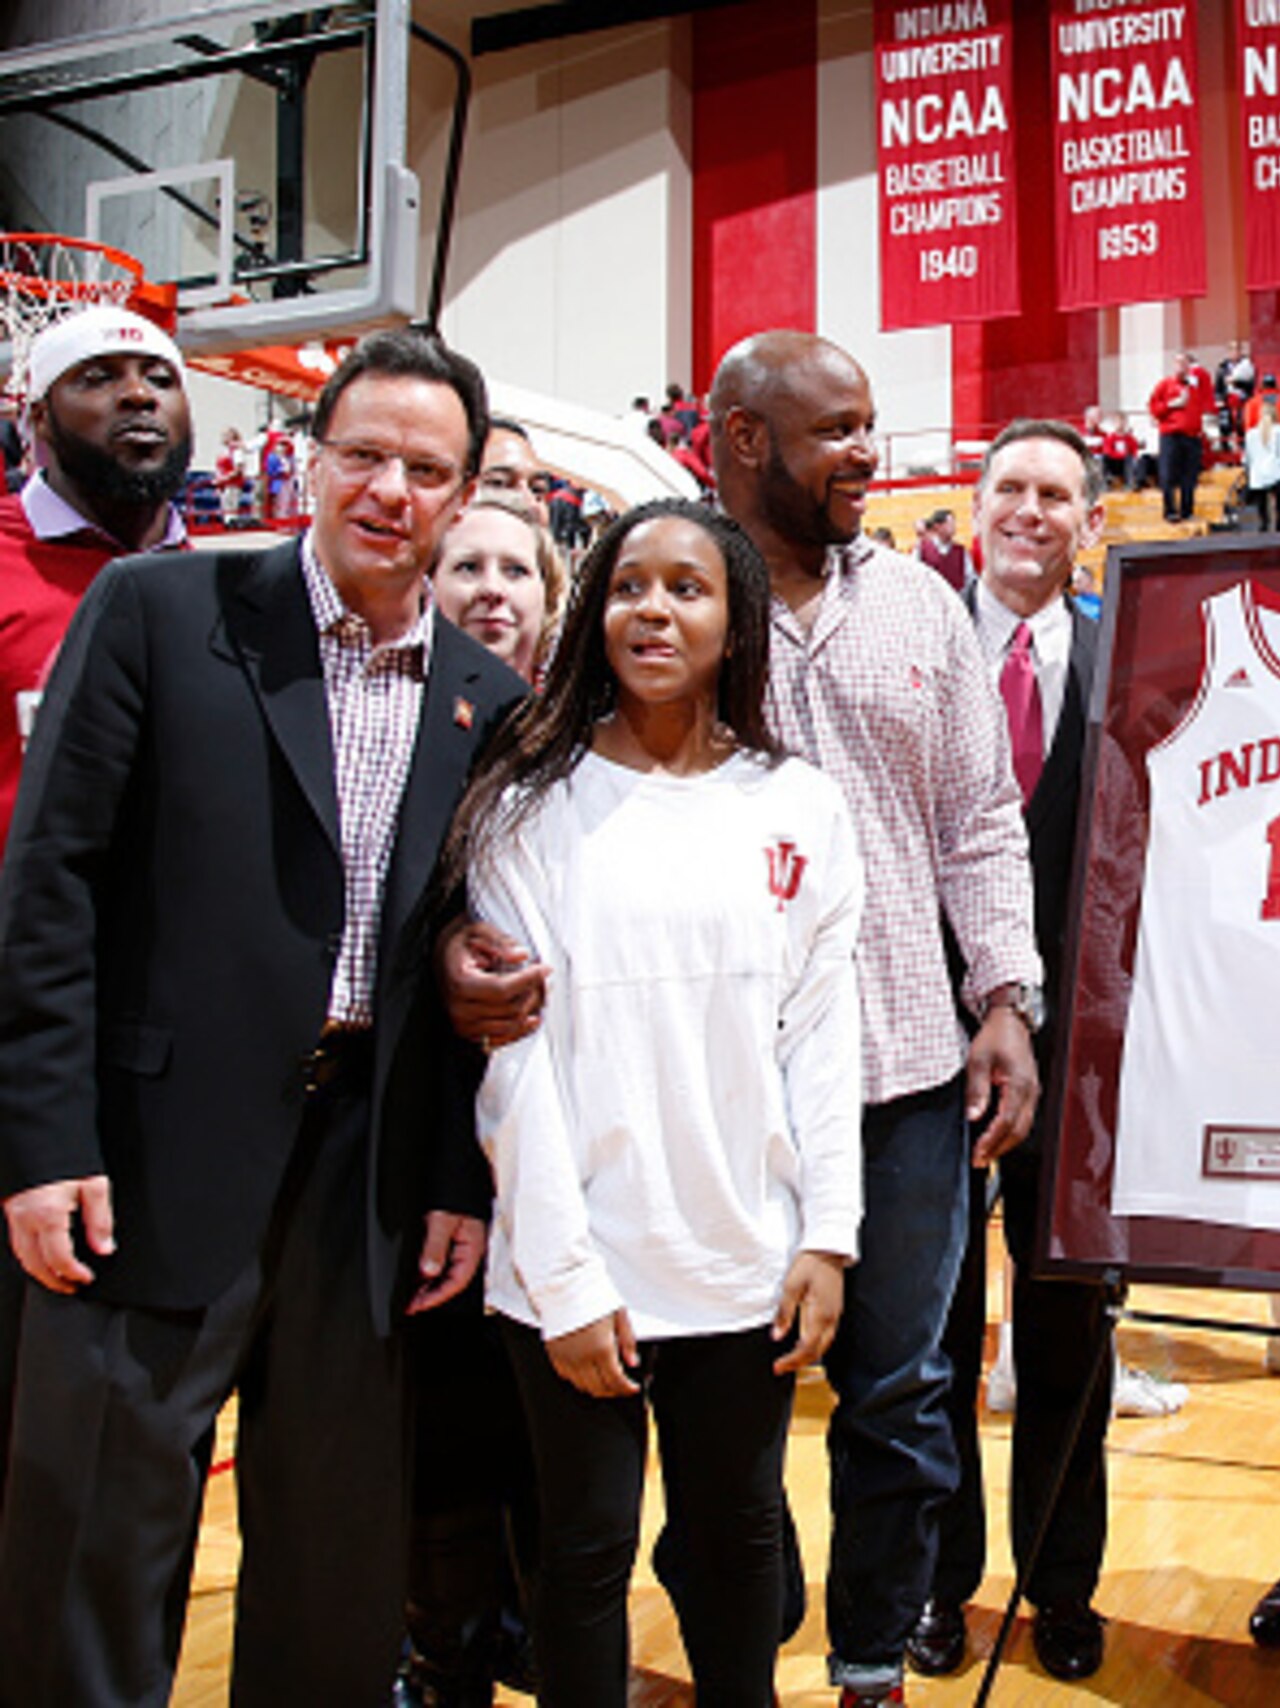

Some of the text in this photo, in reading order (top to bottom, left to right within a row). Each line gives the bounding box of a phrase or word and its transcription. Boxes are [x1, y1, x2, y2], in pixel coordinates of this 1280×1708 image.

[894, 0, 988, 40] INDIANA
[1058, 4, 1186, 55] UNIVERSITY
[881, 33, 1003, 83] UNIVERSITY
[1058, 57, 1193, 122] NCAA
[881, 86, 1008, 148] NCAA
[1063, 125, 1189, 174] BASKETBALL
[886, 151, 1004, 197] BASKETBALL
[1070, 168, 1186, 214] CHAMPIONS
[890, 192, 1001, 235] CHAMPIONS
[919, 246, 978, 281] 1940
[1098, 221, 1158, 260] 1953
